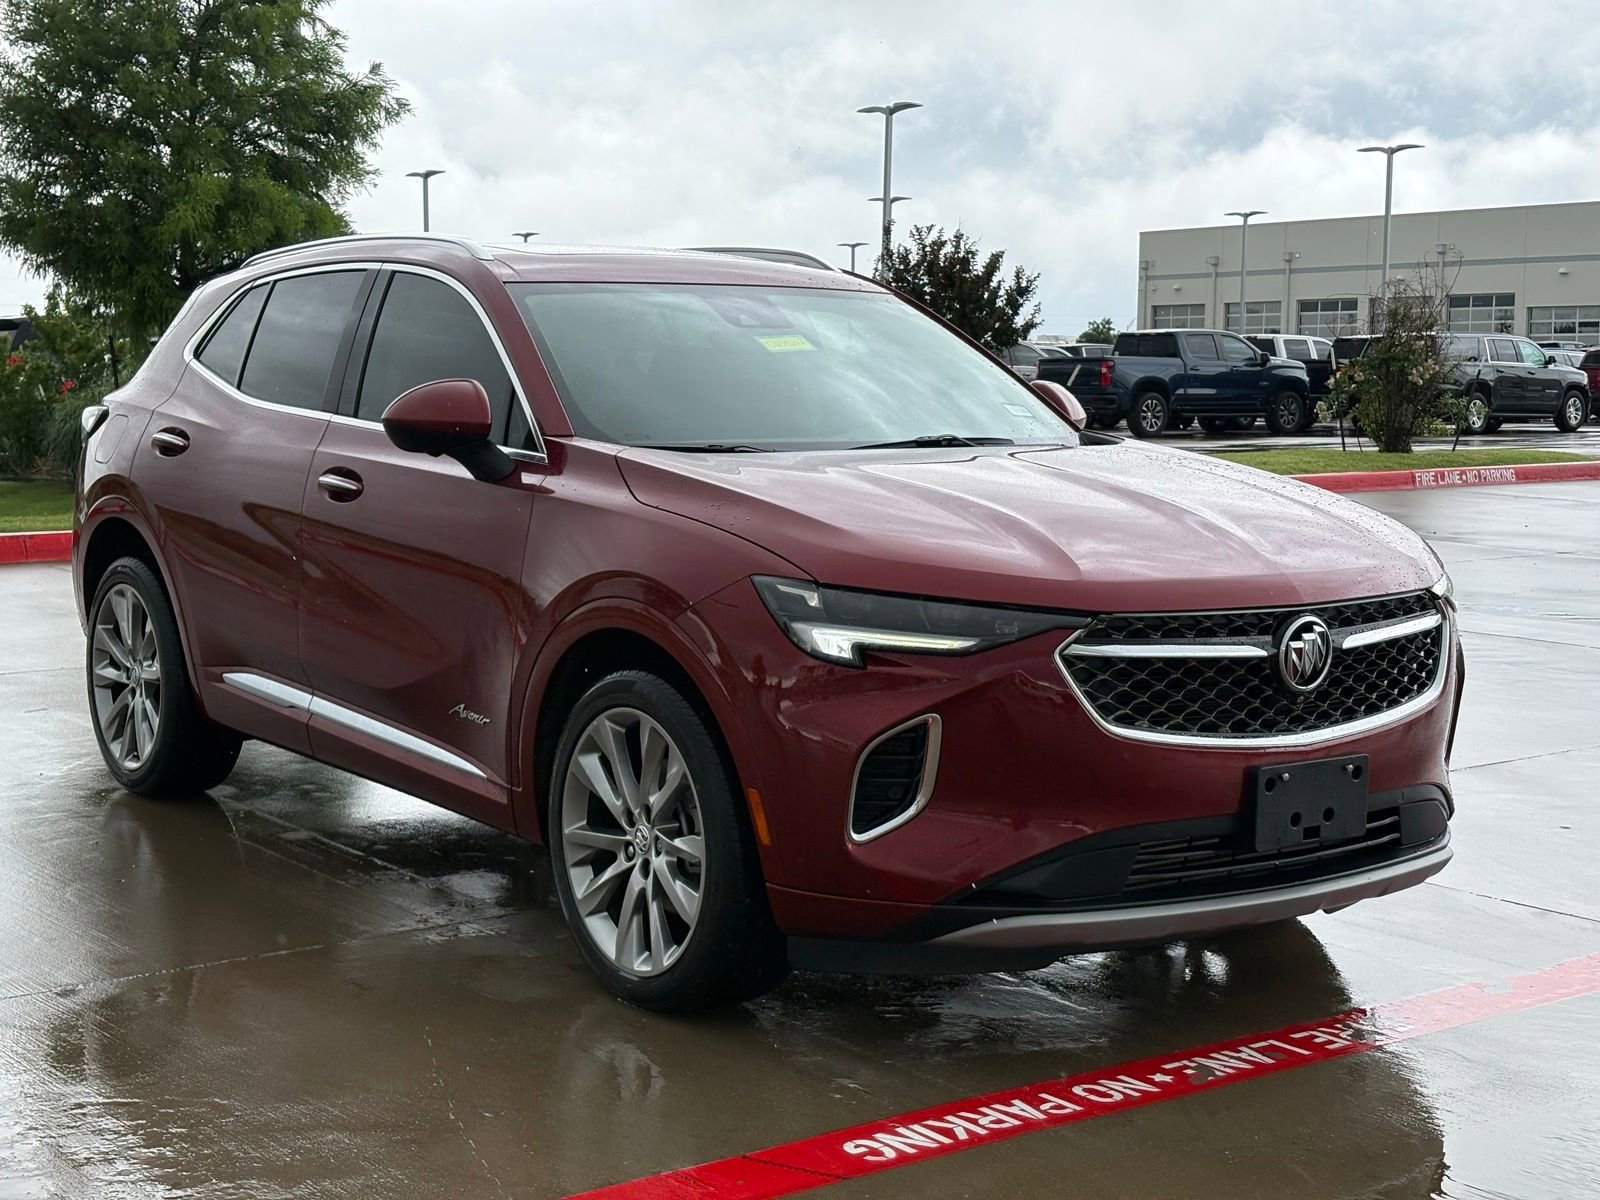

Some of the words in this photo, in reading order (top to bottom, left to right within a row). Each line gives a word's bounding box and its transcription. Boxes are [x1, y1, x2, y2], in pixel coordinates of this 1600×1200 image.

[1415, 471, 1437, 486] FIRE
[1438, 470, 1462, 485] LANE
[1466, 470, 1479, 483] NO
[1481, 468, 1516, 482] PARKING
[1160, 1039, 1313, 1080] LANE
[1071, 1074, 1162, 1103] NO
[842, 1093, 1085, 1162] PARKING
